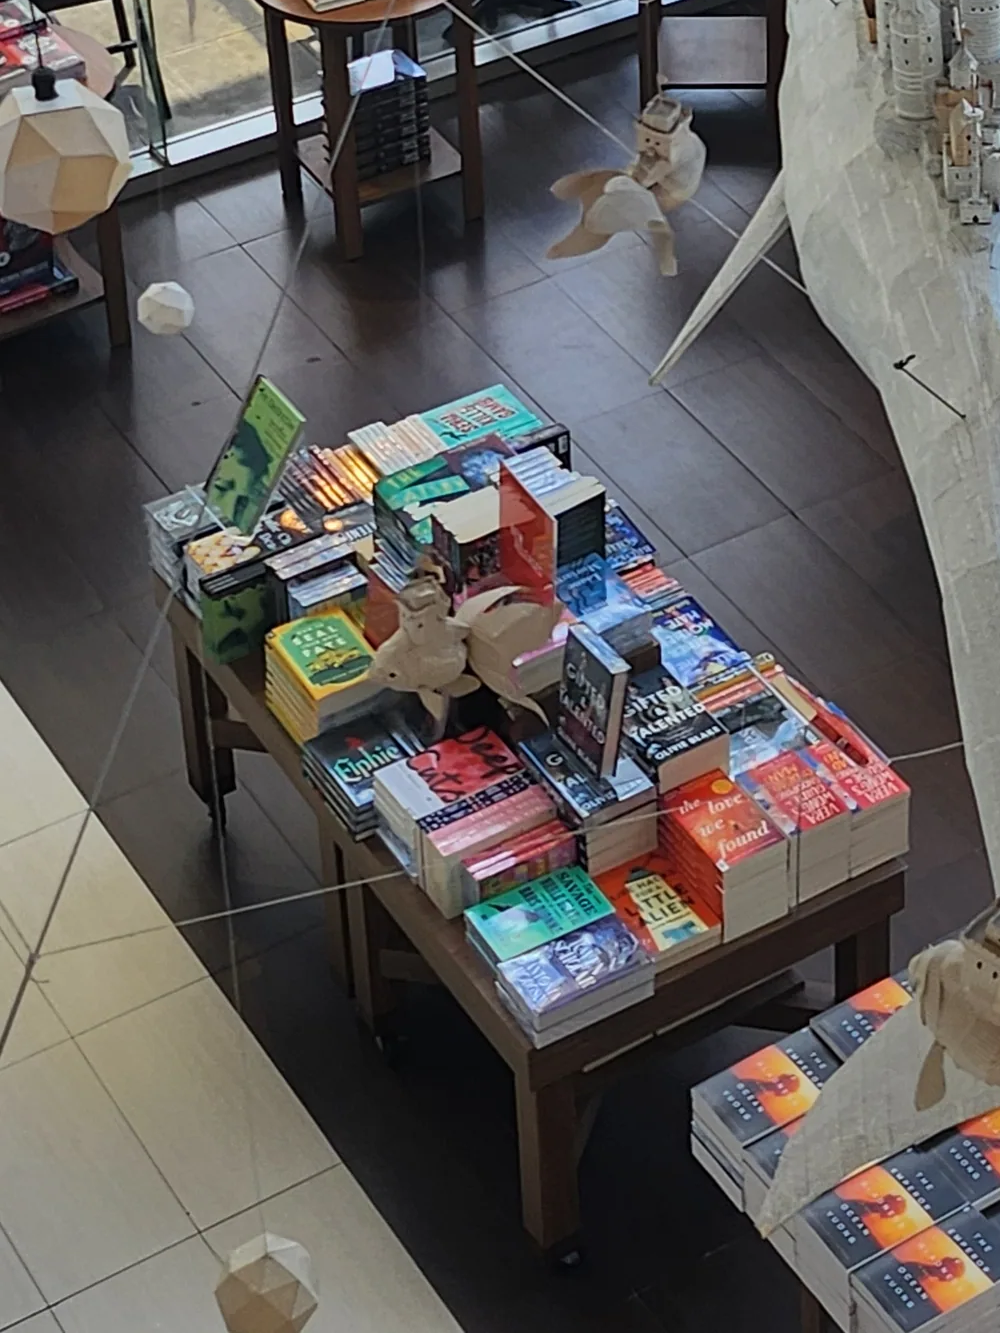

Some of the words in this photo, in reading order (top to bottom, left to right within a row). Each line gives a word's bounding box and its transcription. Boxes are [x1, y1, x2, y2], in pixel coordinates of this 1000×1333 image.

[291, 625, 339, 646] SEAL
[301, 637, 347, 658] FATE
[629, 703, 706, 747] TALENTED
[653, 739, 690, 761] OLIVIE
[689, 725, 722, 746] BLAKE
[333, 743, 401, 783] Elphie
[678, 797, 701, 815] the
[707, 791, 745, 816] love
[804, 801, 842, 827] VERA
[698, 817, 727, 838] we
[715, 819, 771, 859] found
[556, 871, 598, 916] SAVAGE
[638, 896, 696, 927] ALIEN
[810, 1051, 827, 1070] THE
[722, 1090, 752, 1121] VUONG
[736, 1082, 765, 1113] OCEAN
[949, 1147, 981, 1180] VUONG
[962, 1139, 993, 1172] OCEAN
[916, 1171, 935, 1191] THE
[826, 1210, 857, 1244] VUONG
[840, 1203, 870, 1236] OCEAN
[972, 1232, 994, 1253] THE
[883, 1273, 916, 1309] VUONG
[896, 1266, 929, 1301] OCEAN
